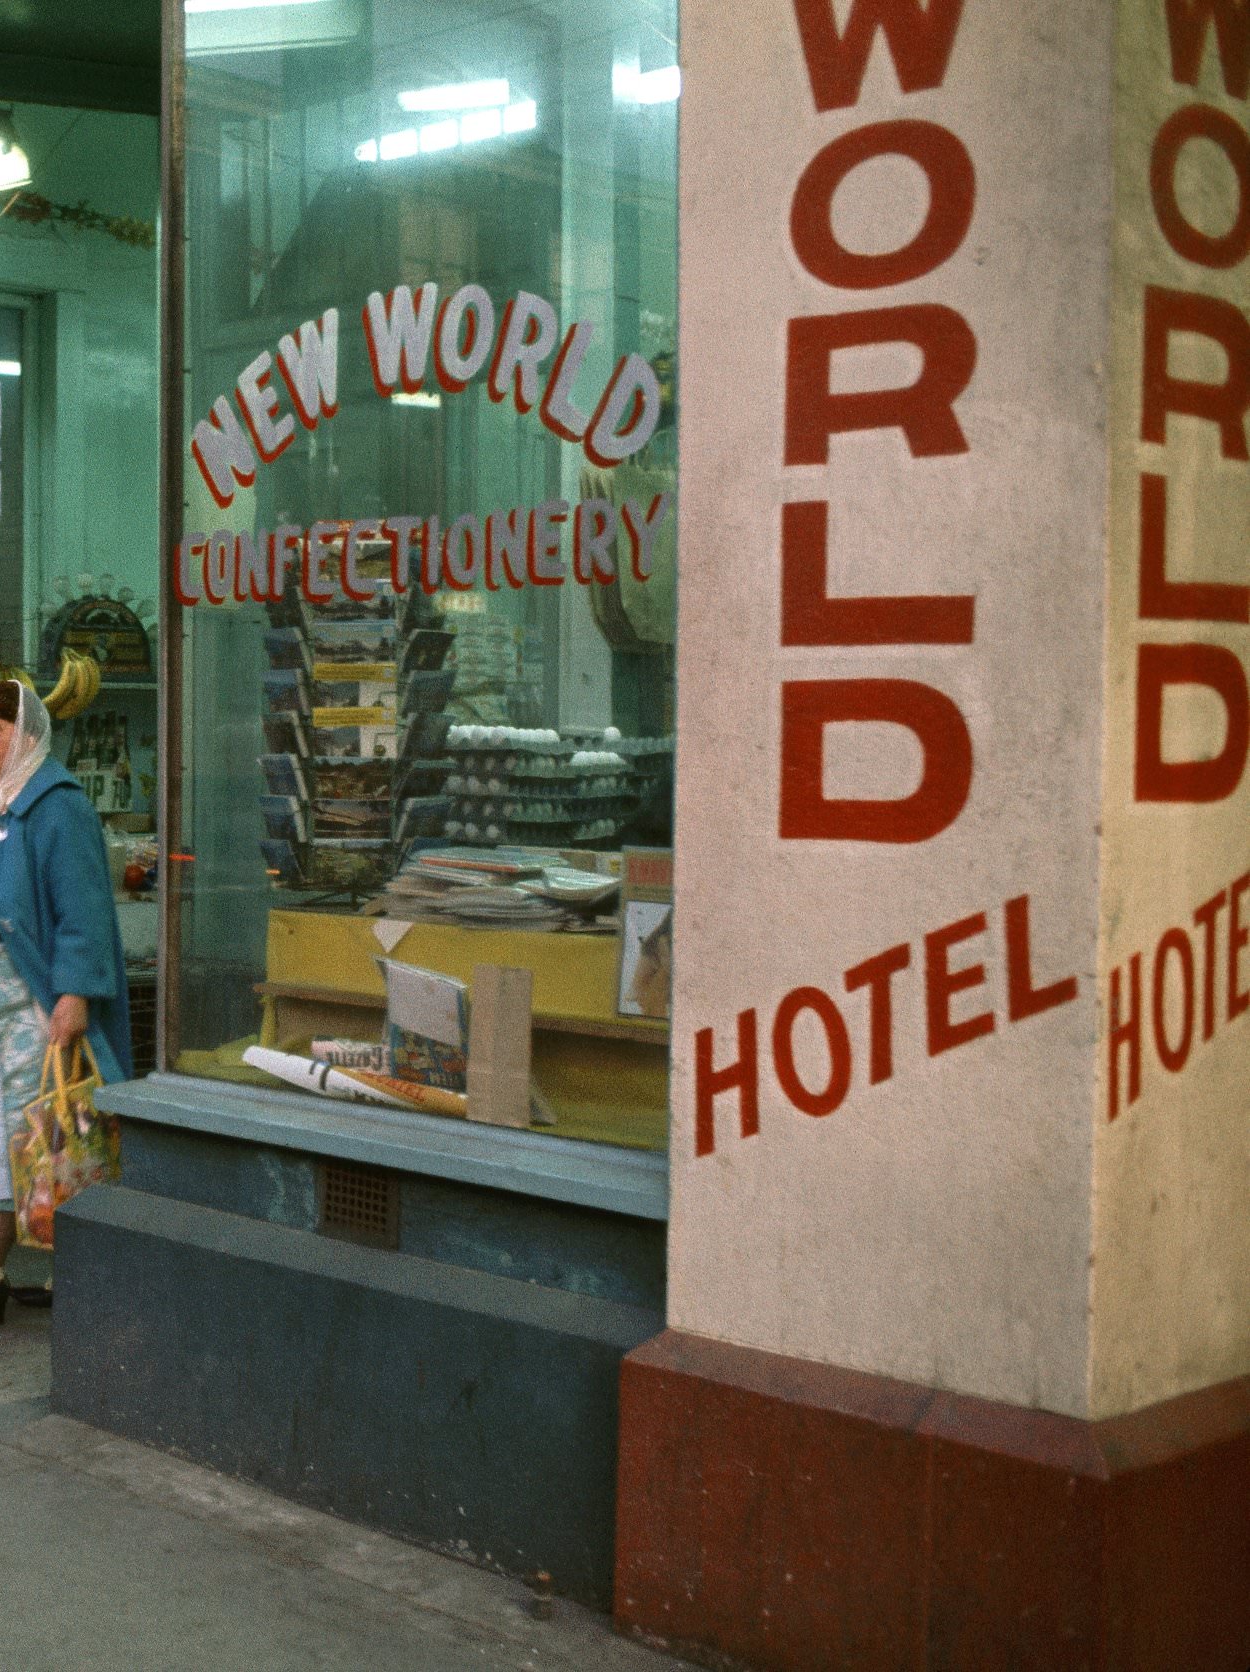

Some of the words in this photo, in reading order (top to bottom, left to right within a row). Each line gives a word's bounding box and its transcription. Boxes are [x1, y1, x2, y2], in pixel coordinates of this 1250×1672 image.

[191, 307, 339, 509] NEW
[362, 281, 661, 468] WORLD
[779, 0, 977, 844] WORLD
[173, 493, 672, 607] CONFECTIONERY
[695, 894, 1078, 1158] HOTEL
